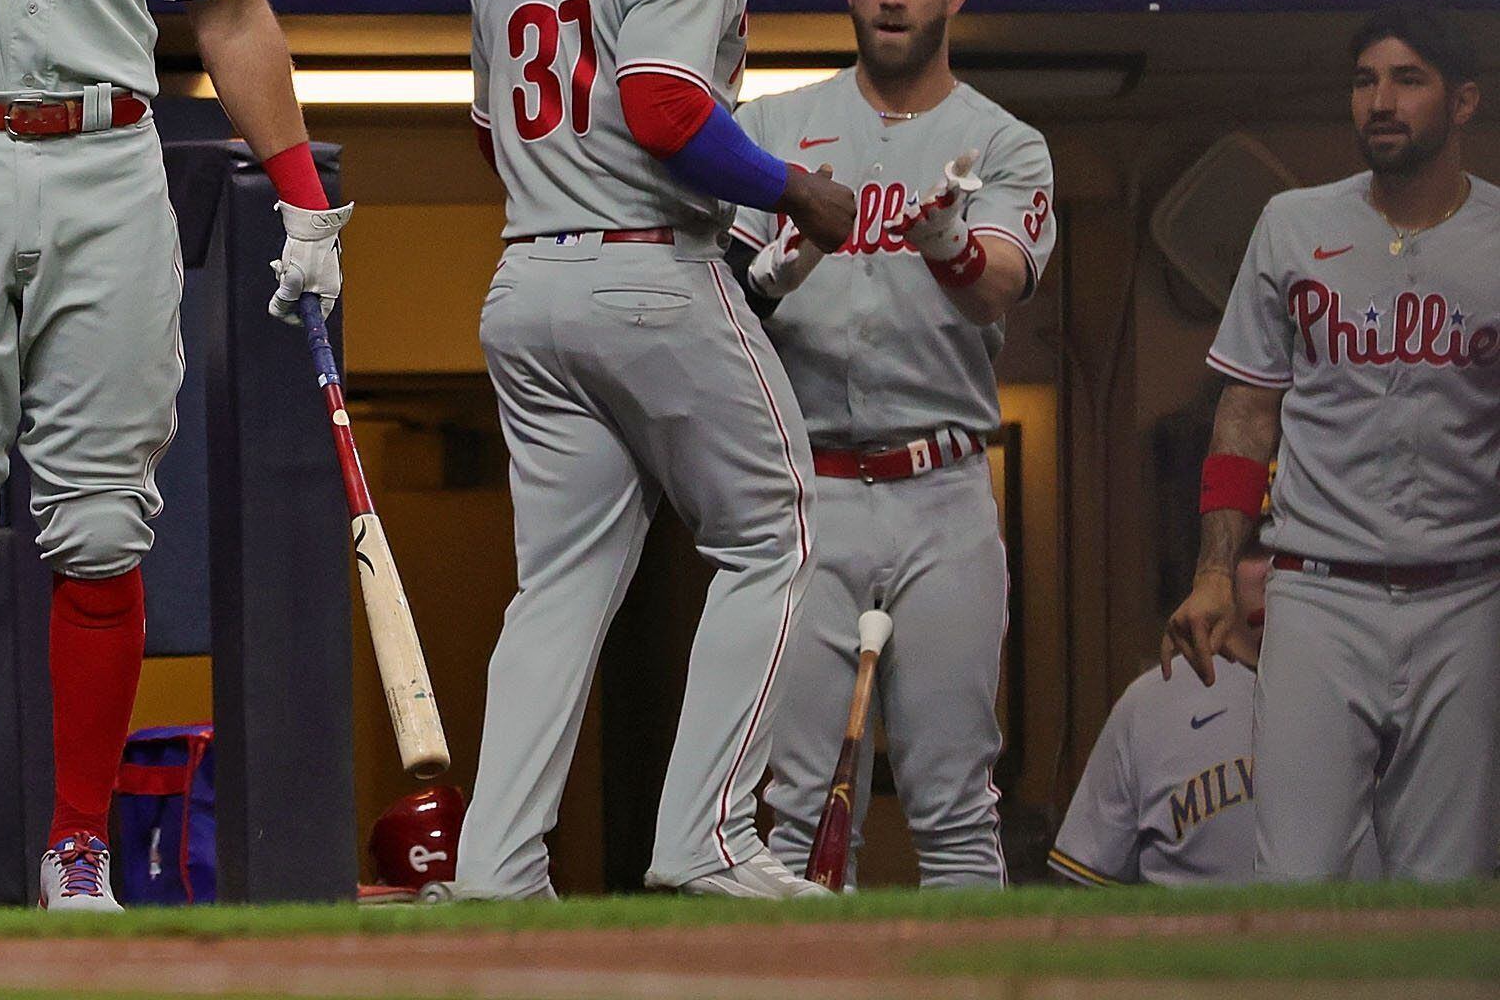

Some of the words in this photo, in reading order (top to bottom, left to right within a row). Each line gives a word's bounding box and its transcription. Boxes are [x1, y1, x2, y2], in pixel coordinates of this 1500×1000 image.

[1023, 189, 1052, 244] 3
[1288, 278, 1500, 368] Phillie
[408, 844, 448, 873] P
